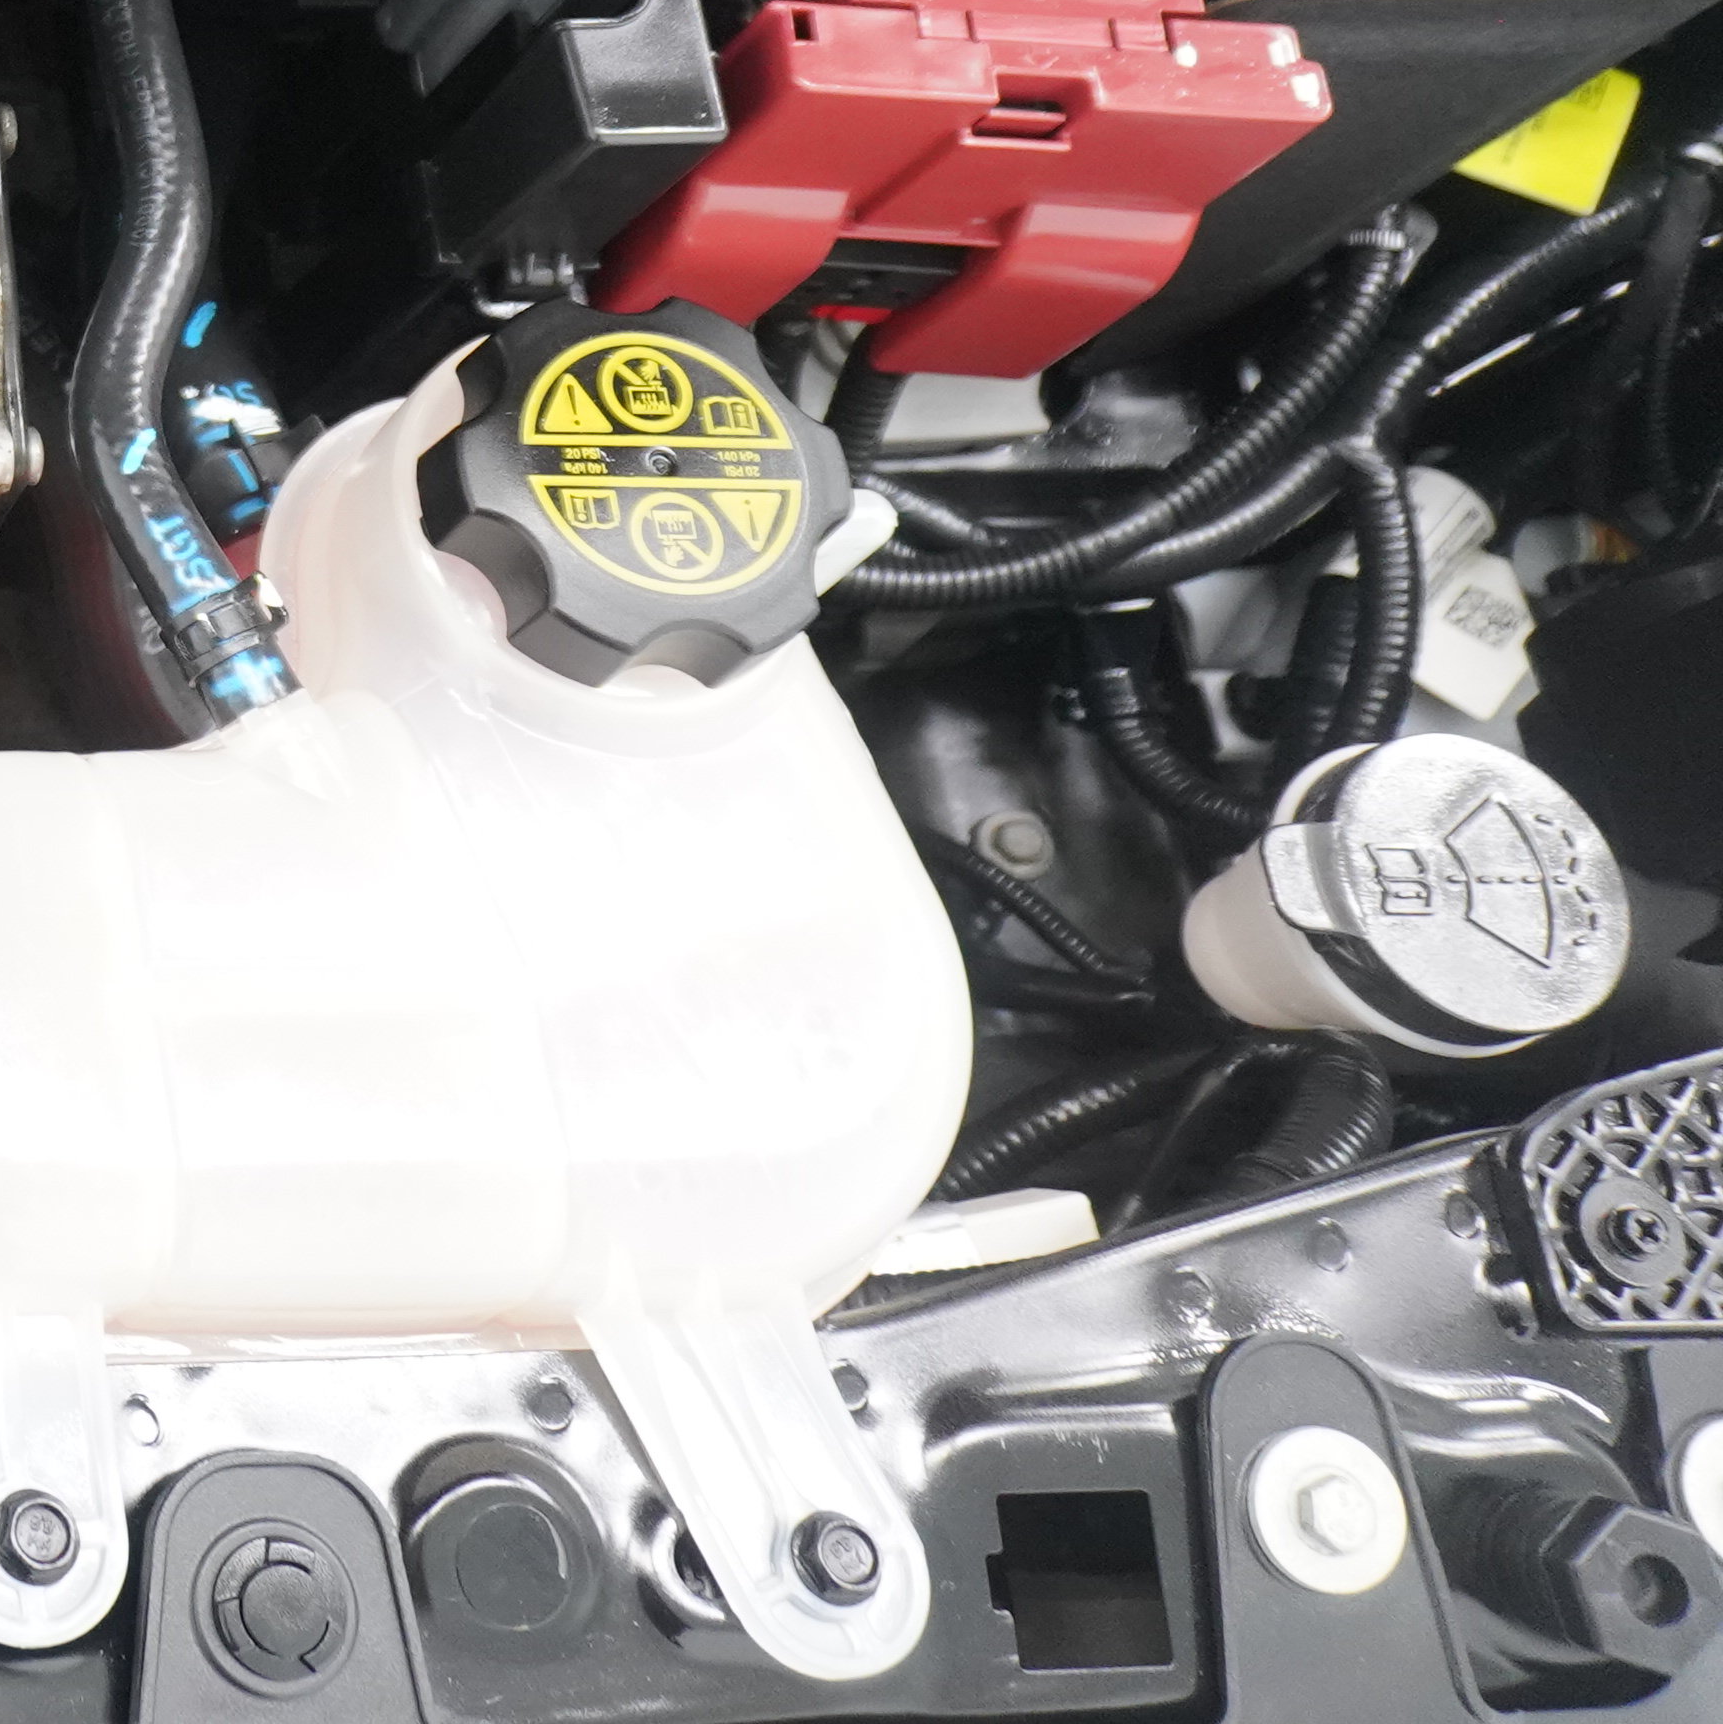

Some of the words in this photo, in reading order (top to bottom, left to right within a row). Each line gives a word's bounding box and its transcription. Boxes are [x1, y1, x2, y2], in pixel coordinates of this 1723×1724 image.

[566, 448, 580, 459] 20
[582, 448, 600, 459] PSI
[718, 450, 738, 462] 140
[740, 451, 761, 462] kPa
[564, 462, 586, 474] kPa
[588, 463, 608, 474] 140
[724, 465, 743, 476] PSI
[744, 465, 761, 476] 20
[148, 516, 215, 588] SGT
